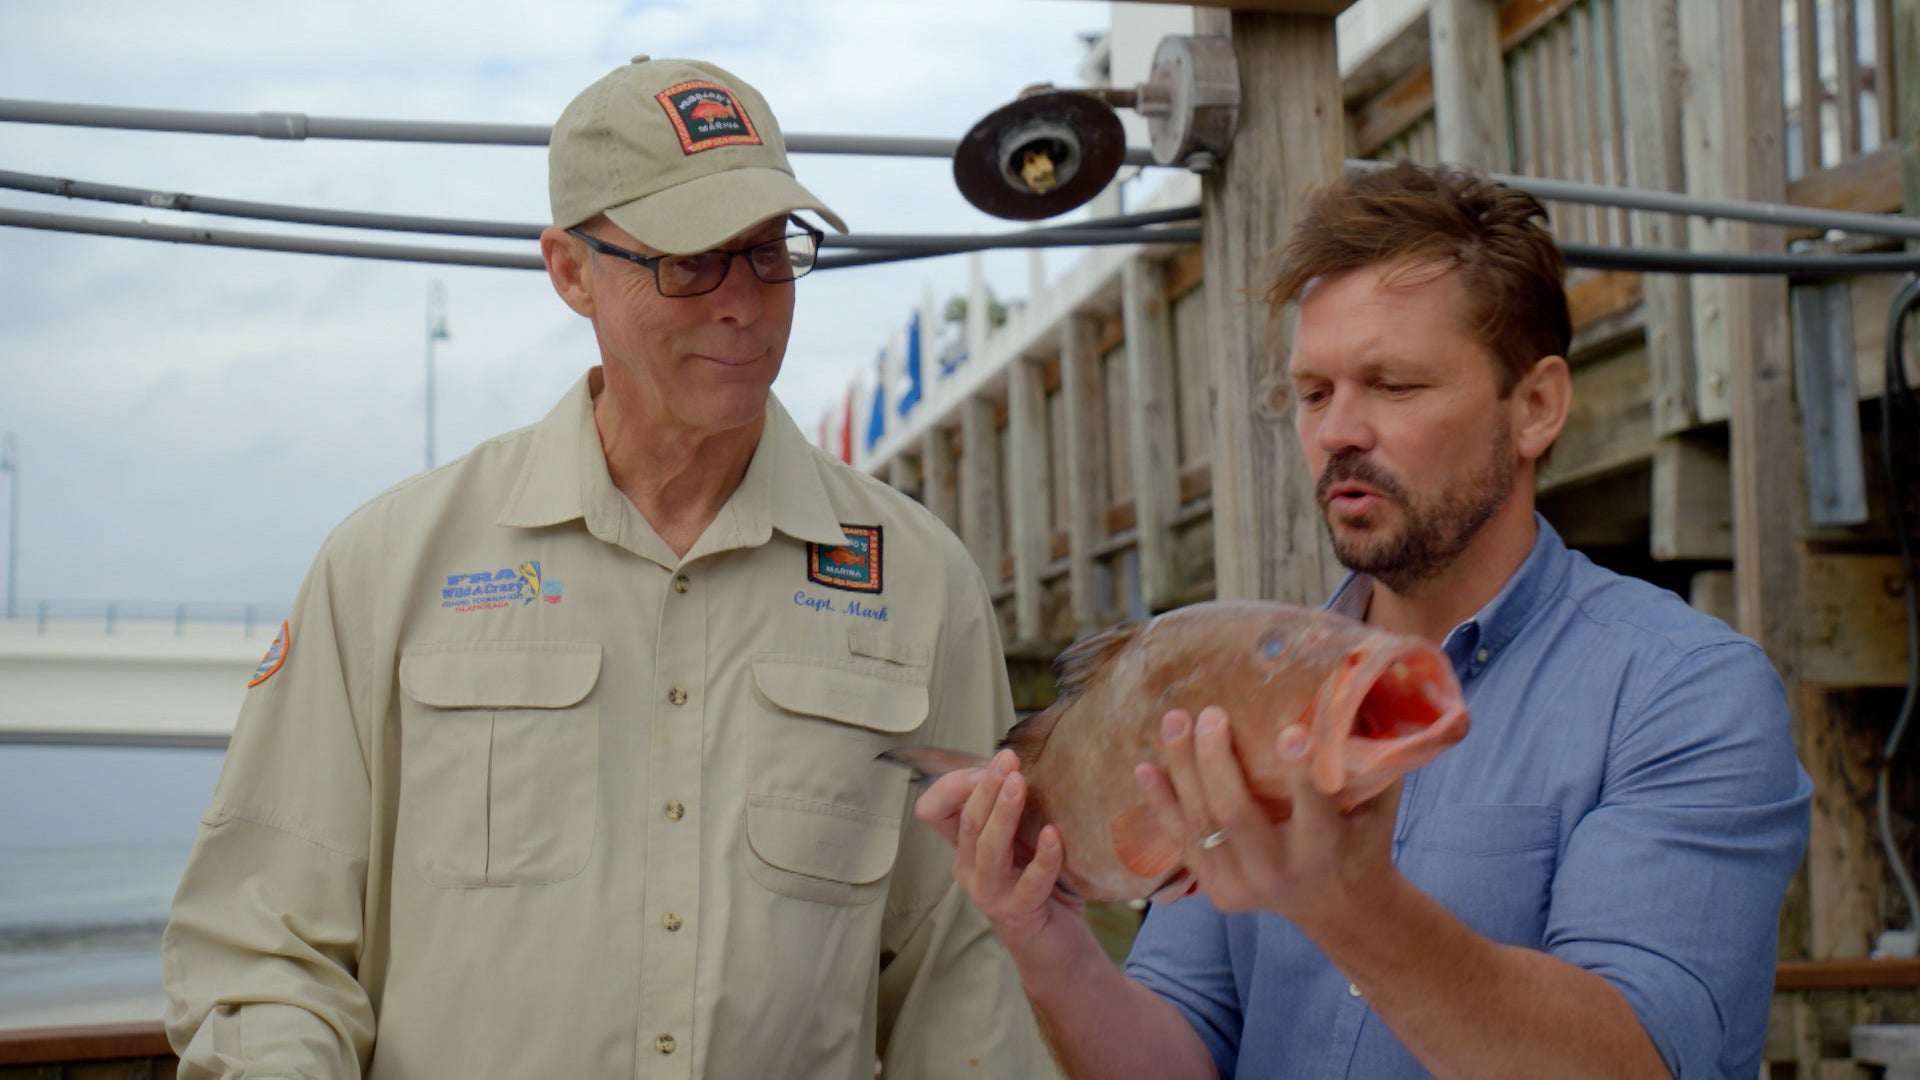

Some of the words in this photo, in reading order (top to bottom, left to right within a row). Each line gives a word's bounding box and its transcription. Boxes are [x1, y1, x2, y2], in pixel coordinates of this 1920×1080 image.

[679, 91, 732, 110] HUBBARD'S
[698, 122, 739, 132] MARINA
[447, 569, 516, 586] FRA
[826, 565, 862, 578] MARINA
[473, 593, 523, 604] TOURNAMENT
[794, 591, 836, 612] Capt.
[843, 601, 888, 622] Mark
